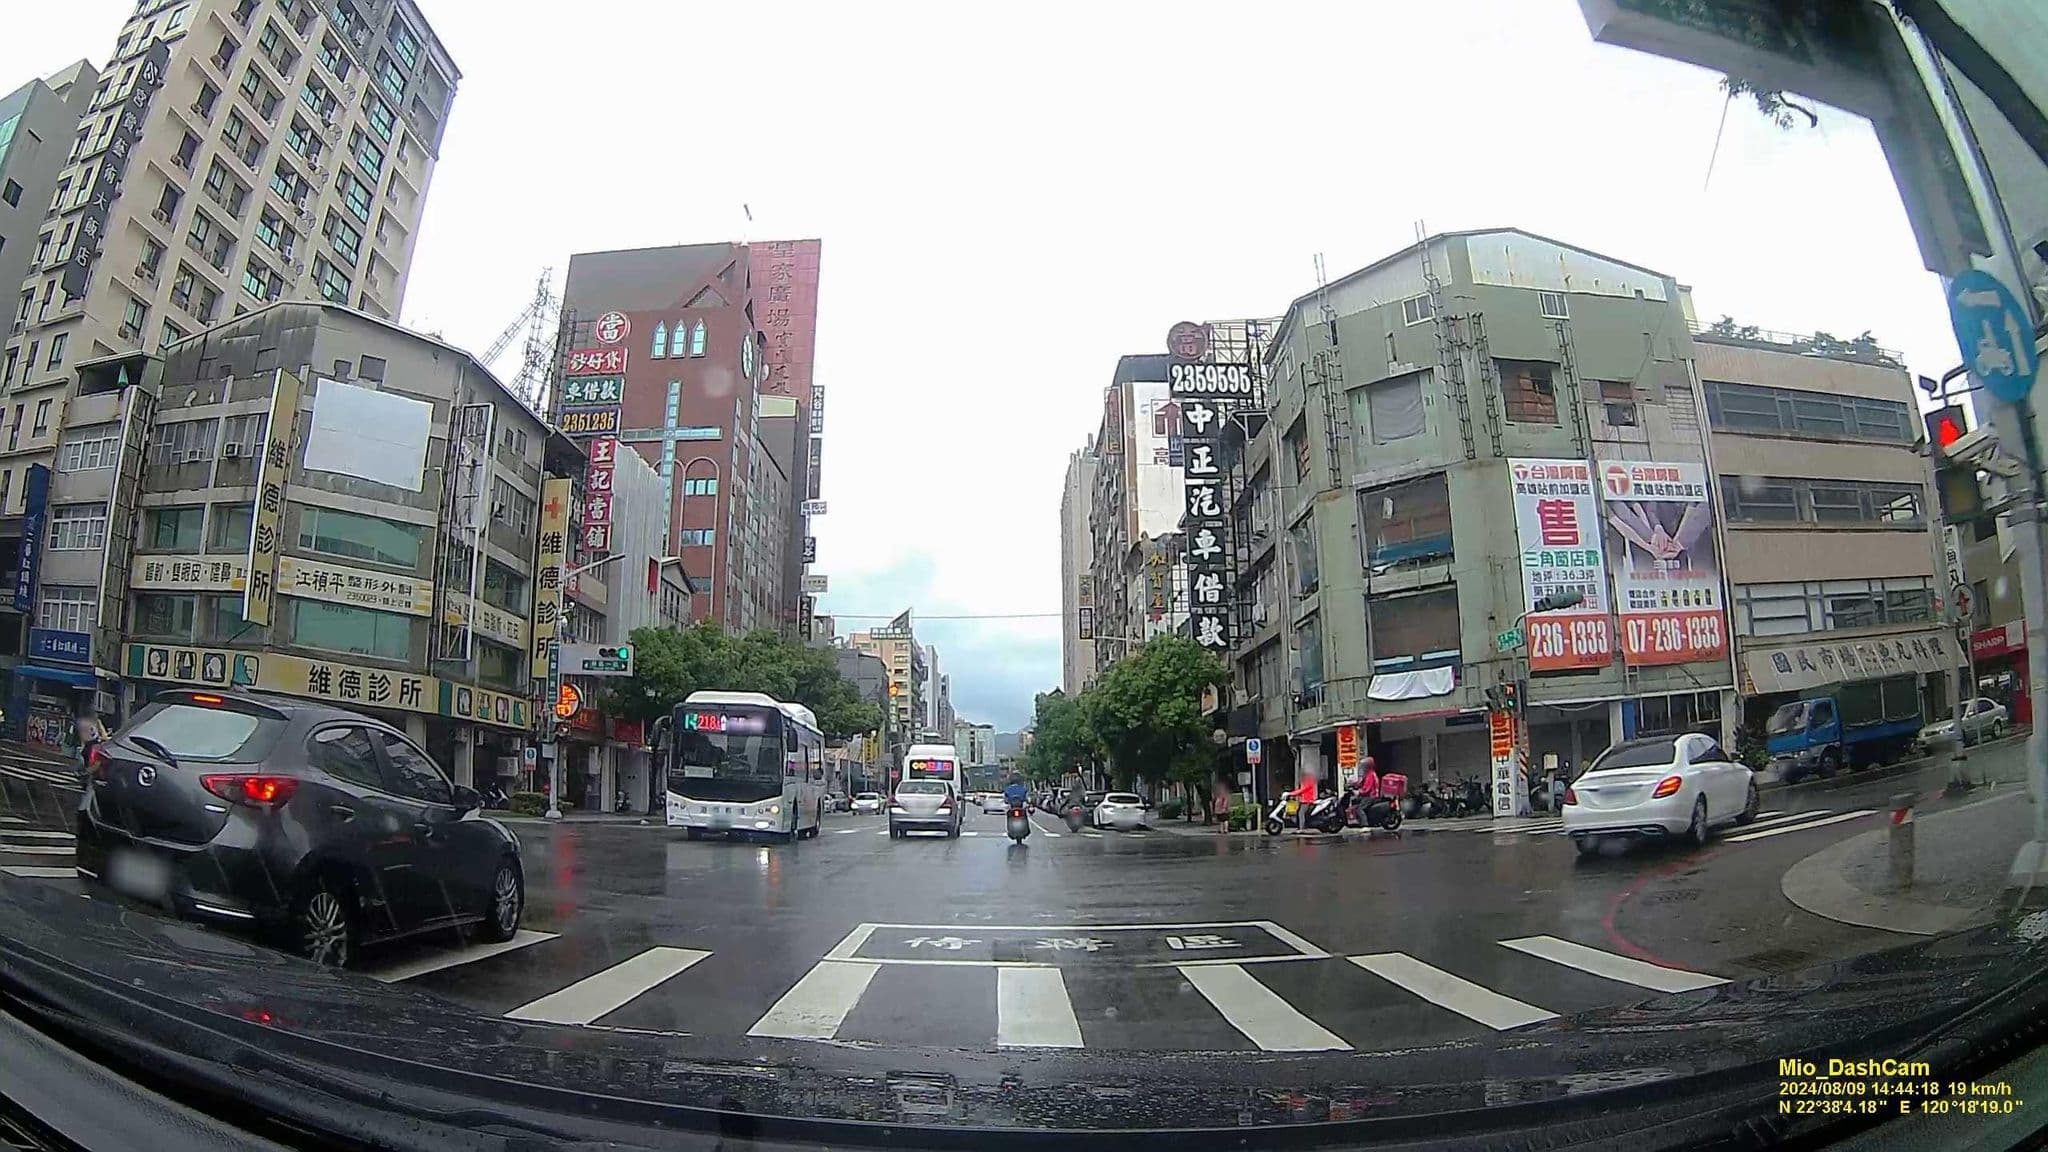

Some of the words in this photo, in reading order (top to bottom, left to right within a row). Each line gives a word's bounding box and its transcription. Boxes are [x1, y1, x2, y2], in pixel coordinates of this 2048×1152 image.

[600, 314, 624, 340] 當
[1171, 364, 1251, 393] 2359595
[562, 411, 615, 432] 2351235
[251, 438, 287, 602] 維德診所
[1185, 402, 1228, 648] 中正汽車借款
[1536, 499, 1579, 545] 售
[533, 532, 563, 660] 維德診所
[1531, 621, 1608, 658] 236-1333
[1627, 616, 1720, 653] 07-236-1333
[308, 664, 422, 707] 維德診所
